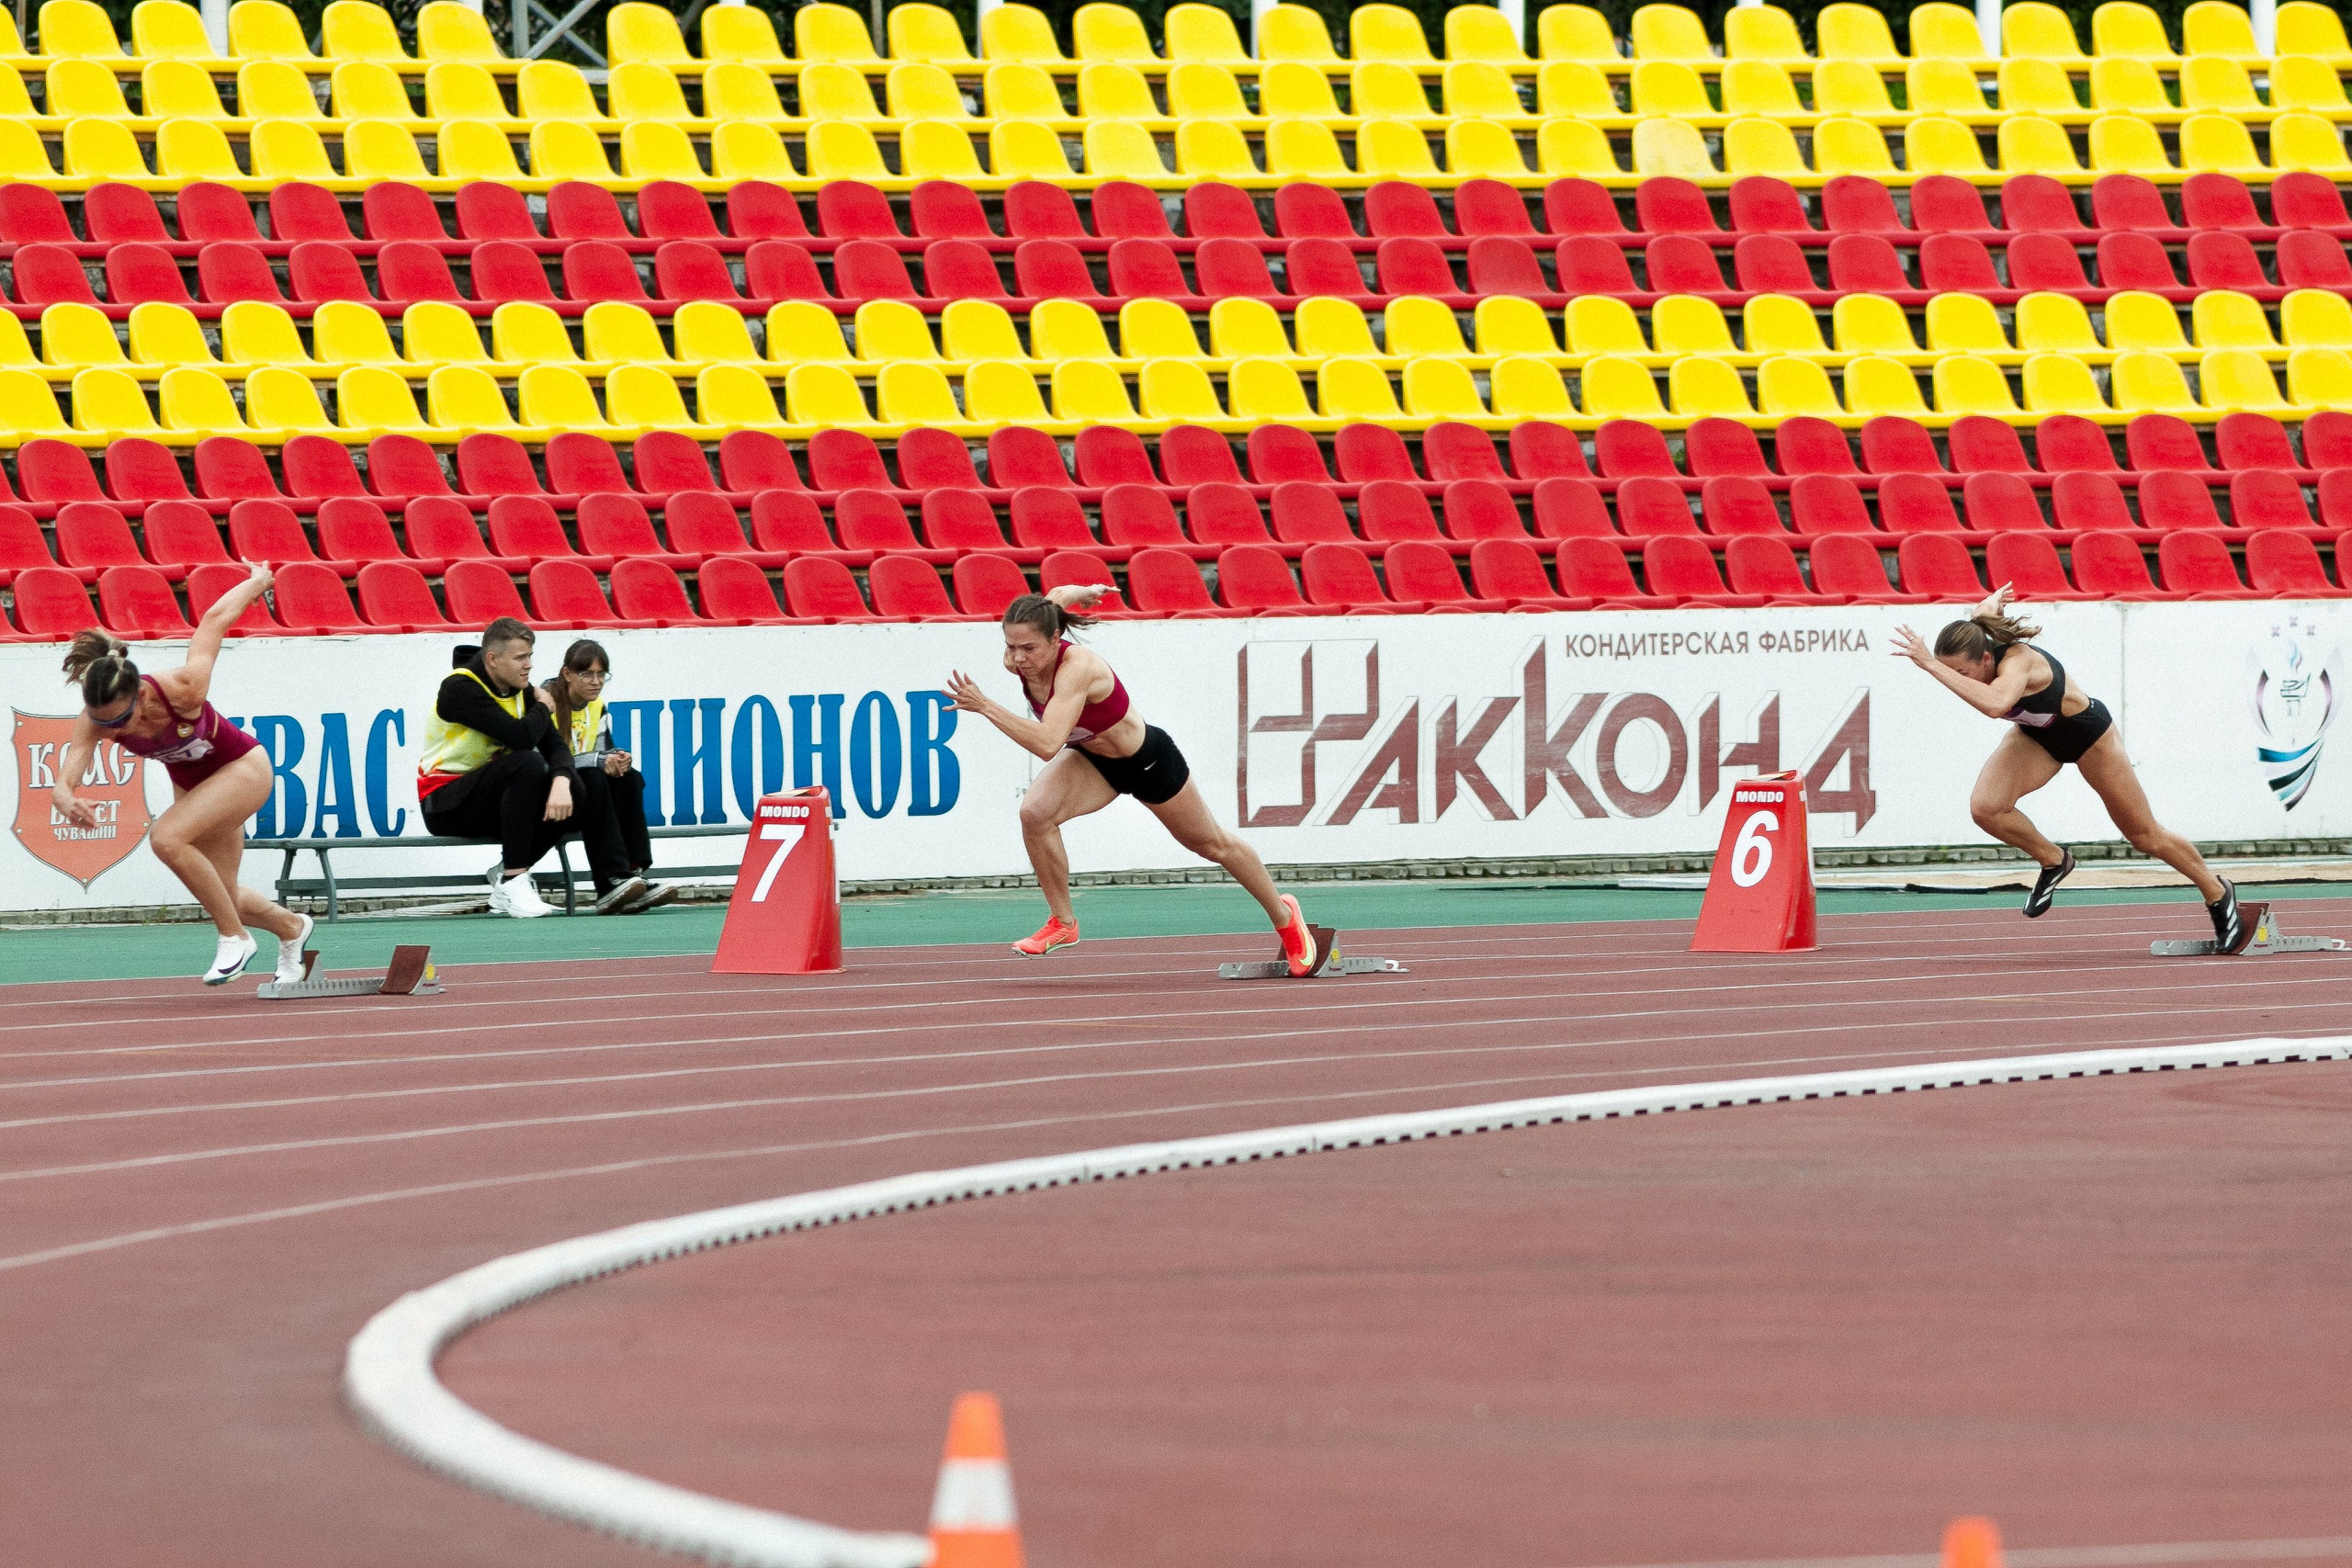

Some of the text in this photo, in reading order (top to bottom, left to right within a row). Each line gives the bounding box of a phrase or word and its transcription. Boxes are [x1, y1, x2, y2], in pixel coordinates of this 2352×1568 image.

[1566, 629, 1870, 660] КОНДИТЕРСКАЯ ФАБРИКА
[227, 691, 961, 840] ВАС ПИОНОВ
[760, 806, 810, 818] MONDO
[1736, 791, 1784, 803] MONDO
[751, 823, 807, 902] 7
[1731, 810, 1780, 887] 6
